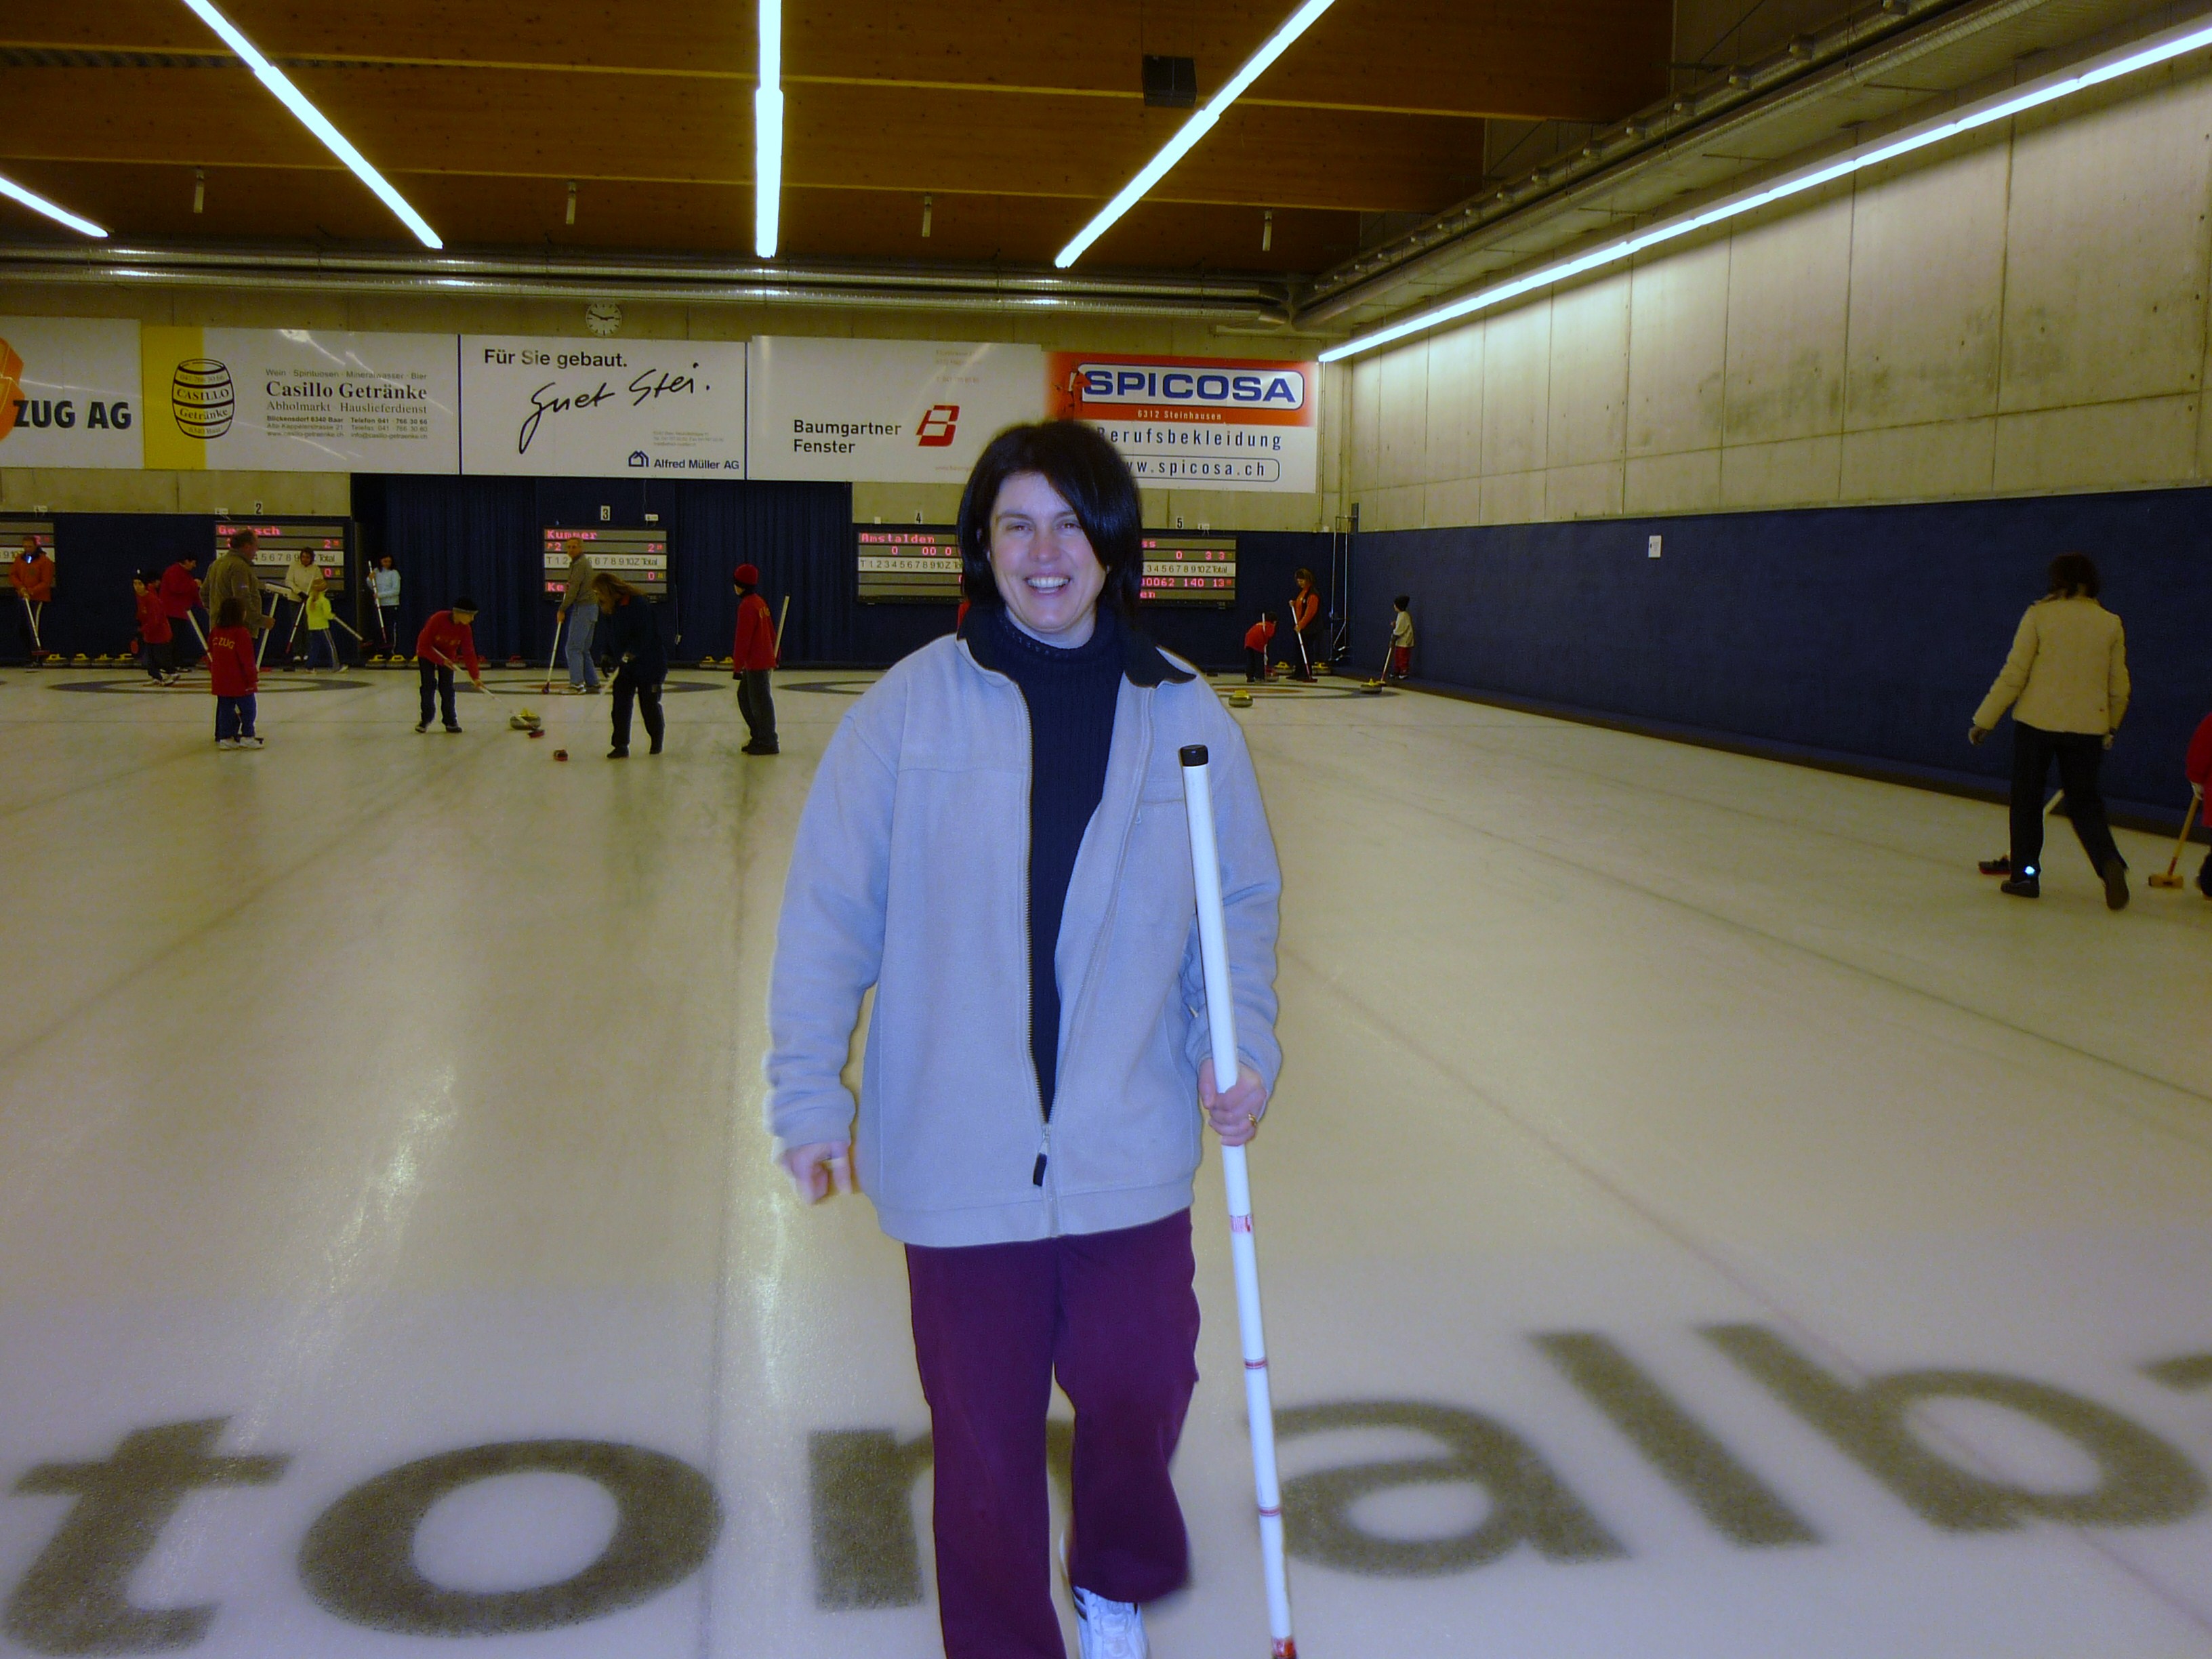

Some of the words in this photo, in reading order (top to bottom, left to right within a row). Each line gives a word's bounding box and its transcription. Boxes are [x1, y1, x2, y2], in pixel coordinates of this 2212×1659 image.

[485, 349, 515, 365] Für
[521, 350, 550, 365] Sie
[557, 352, 628, 369] gebaut.
[293, 369, 339, 377] Spirituosen
[346, 371, 404, 379] Mineralwasser
[266, 380, 333, 398] Casillo
[339, 382, 428, 400] Getränke
[1084, 371, 1296, 403] SPICOSA
[177, 388, 229, 401] CASILLO
[267, 401, 331, 411] Abholmarkt
[340, 403, 427, 413] Hauslieferdienst
[13, 400, 75, 428] ZUG
[87, 401, 131, 430] AG
[1138, 409, 1160, 419] 6312
[1164, 410, 1222, 421] Steinhausen
[794, 419, 901, 437] Baumgartner
[794, 439, 856, 453] Fenster
[654, 459, 685, 468] Alfred
[689, 459, 720, 469] Müller
[724, 460, 739, 470] AG
[255, 503, 262, 514] 2
[602, 508, 609, 520] 3
[916, 512, 922, 523] 4
[1177, 517, 1183, 529] 5
[218, 525, 281, 535] Gesch
[861, 533, 935, 543] Amstalden
[648, 544, 655, 552] 2
[892, 546, 898, 555] 0
[945, 548, 951, 556] 0
[319, 554, 335, 562] Total
[1176, 551, 1183, 560] 0
[1206, 551, 1212, 560] 3
[1219, 552, 1225, 560] 3
[648, 571, 655, 580] 0
[1212, 566, 1227, 574] Total
[219, 637, 235, 649] ZUG
